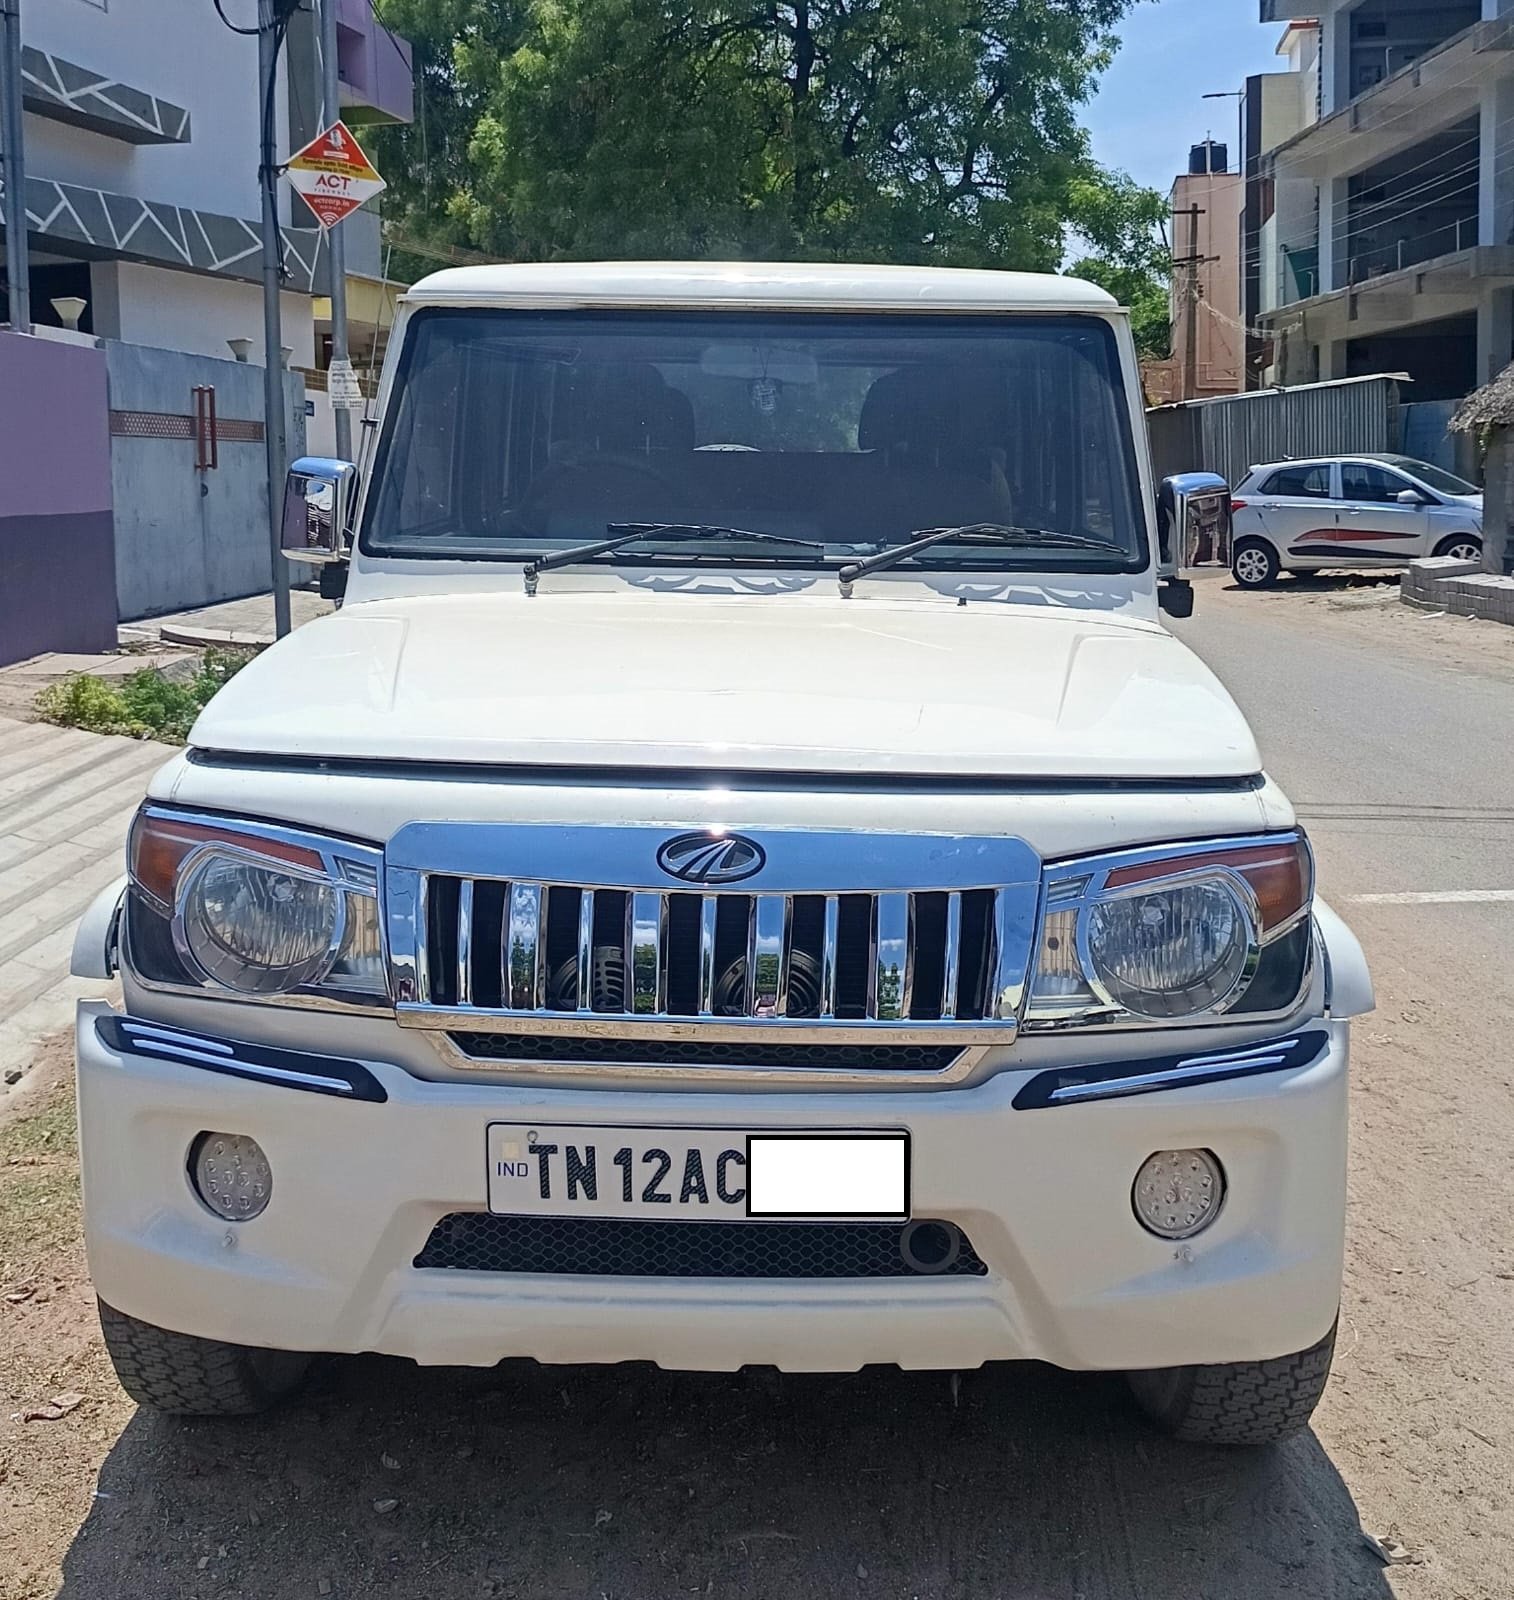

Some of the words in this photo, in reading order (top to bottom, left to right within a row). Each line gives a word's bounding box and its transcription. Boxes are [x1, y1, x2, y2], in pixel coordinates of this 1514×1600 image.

[315, 174, 352, 190] ACT
[497, 1161, 529, 1178] IND
[528, 1144, 598, 1200] TN
